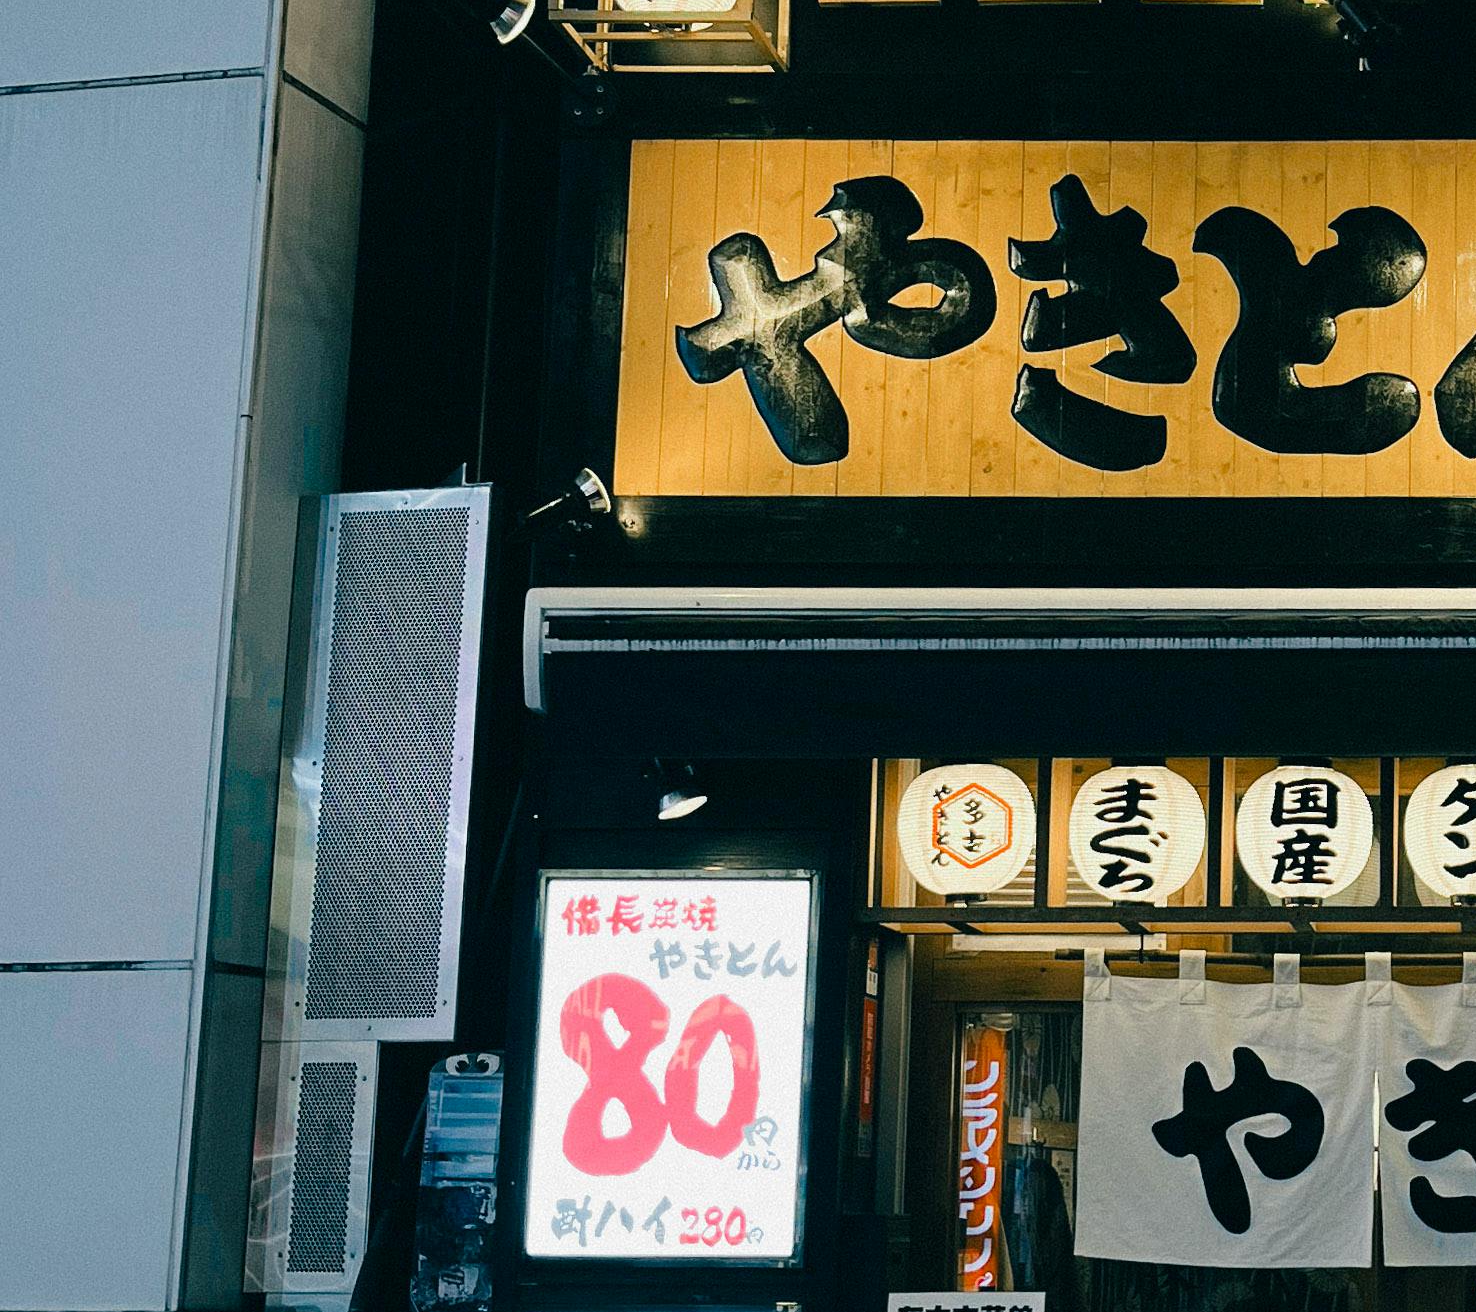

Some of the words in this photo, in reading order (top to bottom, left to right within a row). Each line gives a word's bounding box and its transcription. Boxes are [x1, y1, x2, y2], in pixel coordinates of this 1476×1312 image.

[1089, 777, 1170, 894] まぐろ
[1270, 777, 1342, 886] 国産
[561, 893, 720, 937] 備長炭焼
[649, 937, 798, 981] やきとん
[551, 1194, 673, 1247] 酎ハイ
